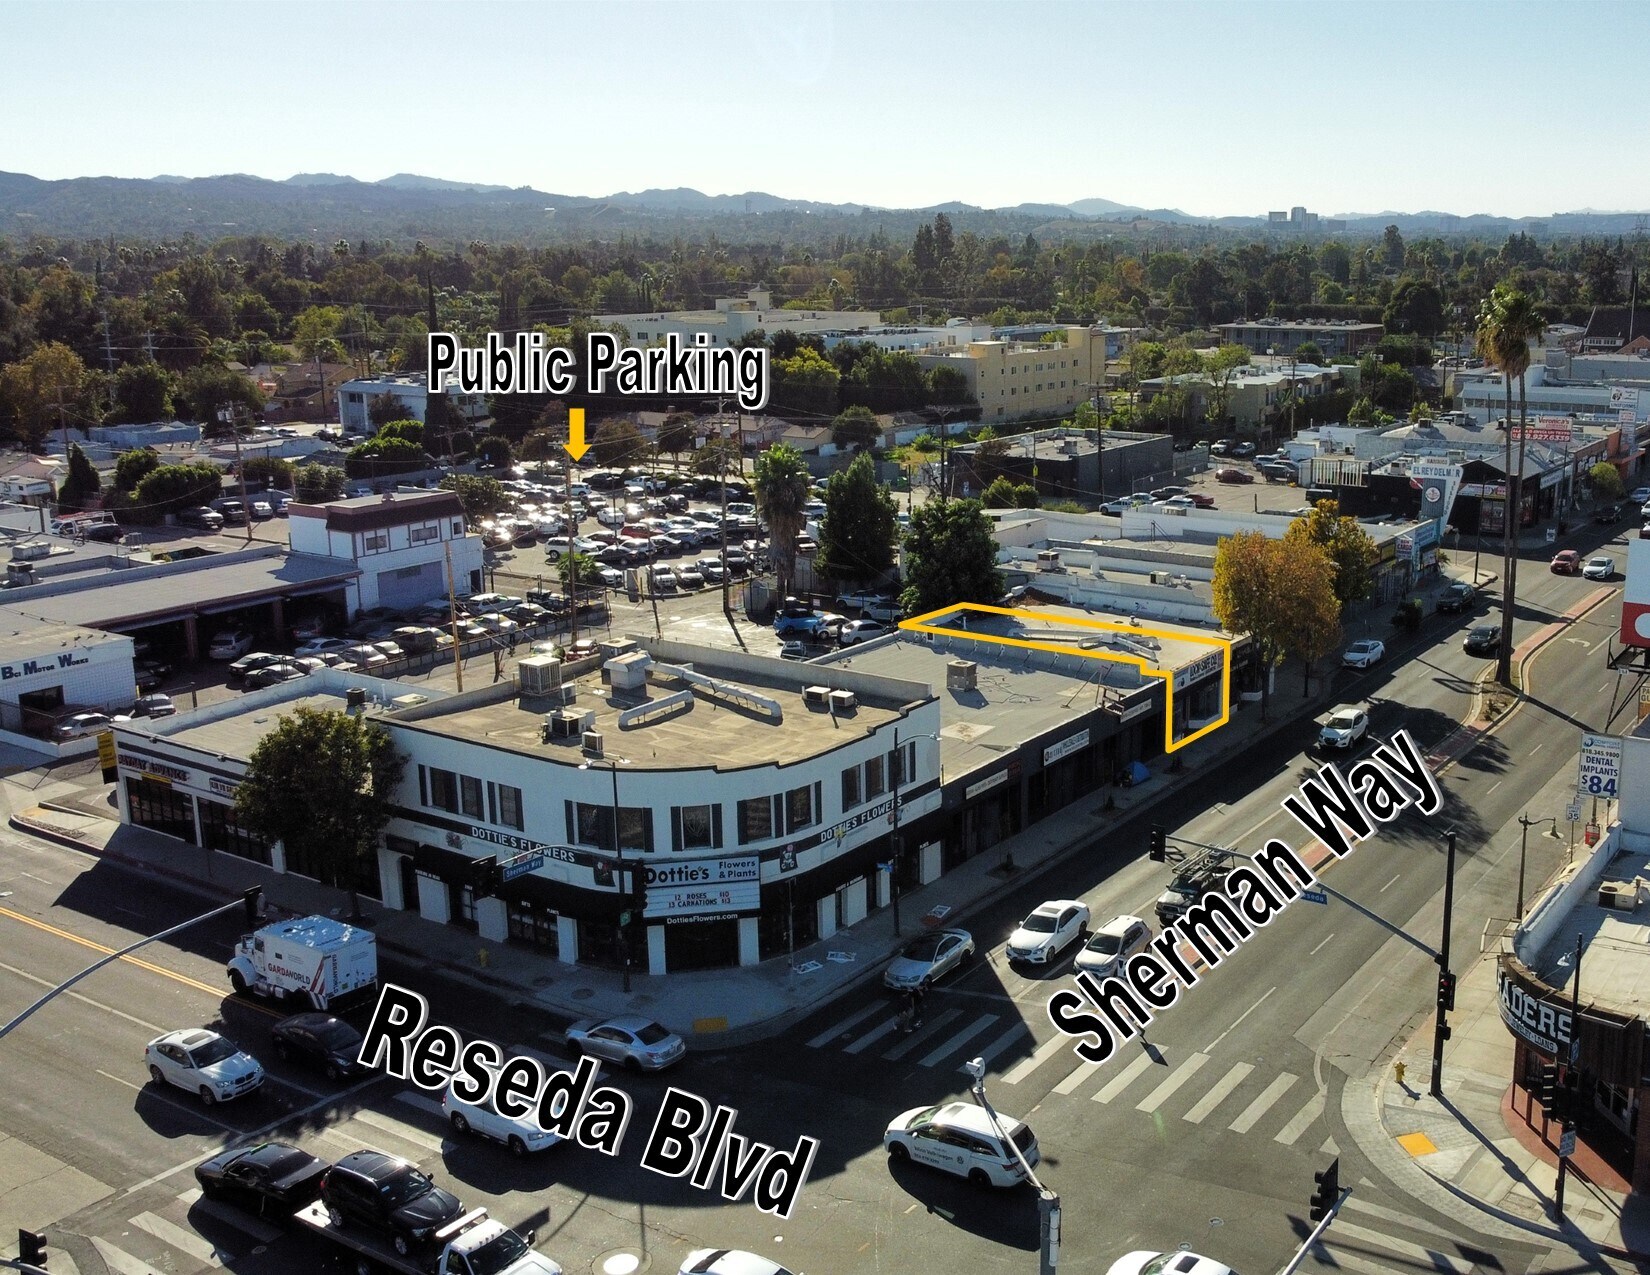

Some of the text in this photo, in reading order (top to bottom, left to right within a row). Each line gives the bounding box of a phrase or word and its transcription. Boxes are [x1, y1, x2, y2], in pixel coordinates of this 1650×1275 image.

[1539, 416, 1570, 424] Veronica's
[1413, 466, 1421, 475] EL
[1422, 466, 1434, 476] REY
[1434, 467, 1446, 476] DEL
[1581, 748, 1620, 759] 818.345.9800
[1585, 755, 1614, 767] DENTAL
[1580, 764, 1618, 777] IMPLANTS
[1581, 774, 1617, 797] $84
[1568, 812, 1579, 820] 35
[471, 826, 575, 862] DOTTIE'S FLOWERS
[506, 859, 542, 878] Sherman Way
[644, 861, 756, 885] Dottie's Flowers
[728, 869, 757, 878] Plants
[677, 899, 718, 908] CARNATIONS
[667, 914, 738, 925] DottiesFlowers.com
[267, 963, 311, 985] GARDAWORLD
[1534, 1033, 1555, 1051] LOANS
